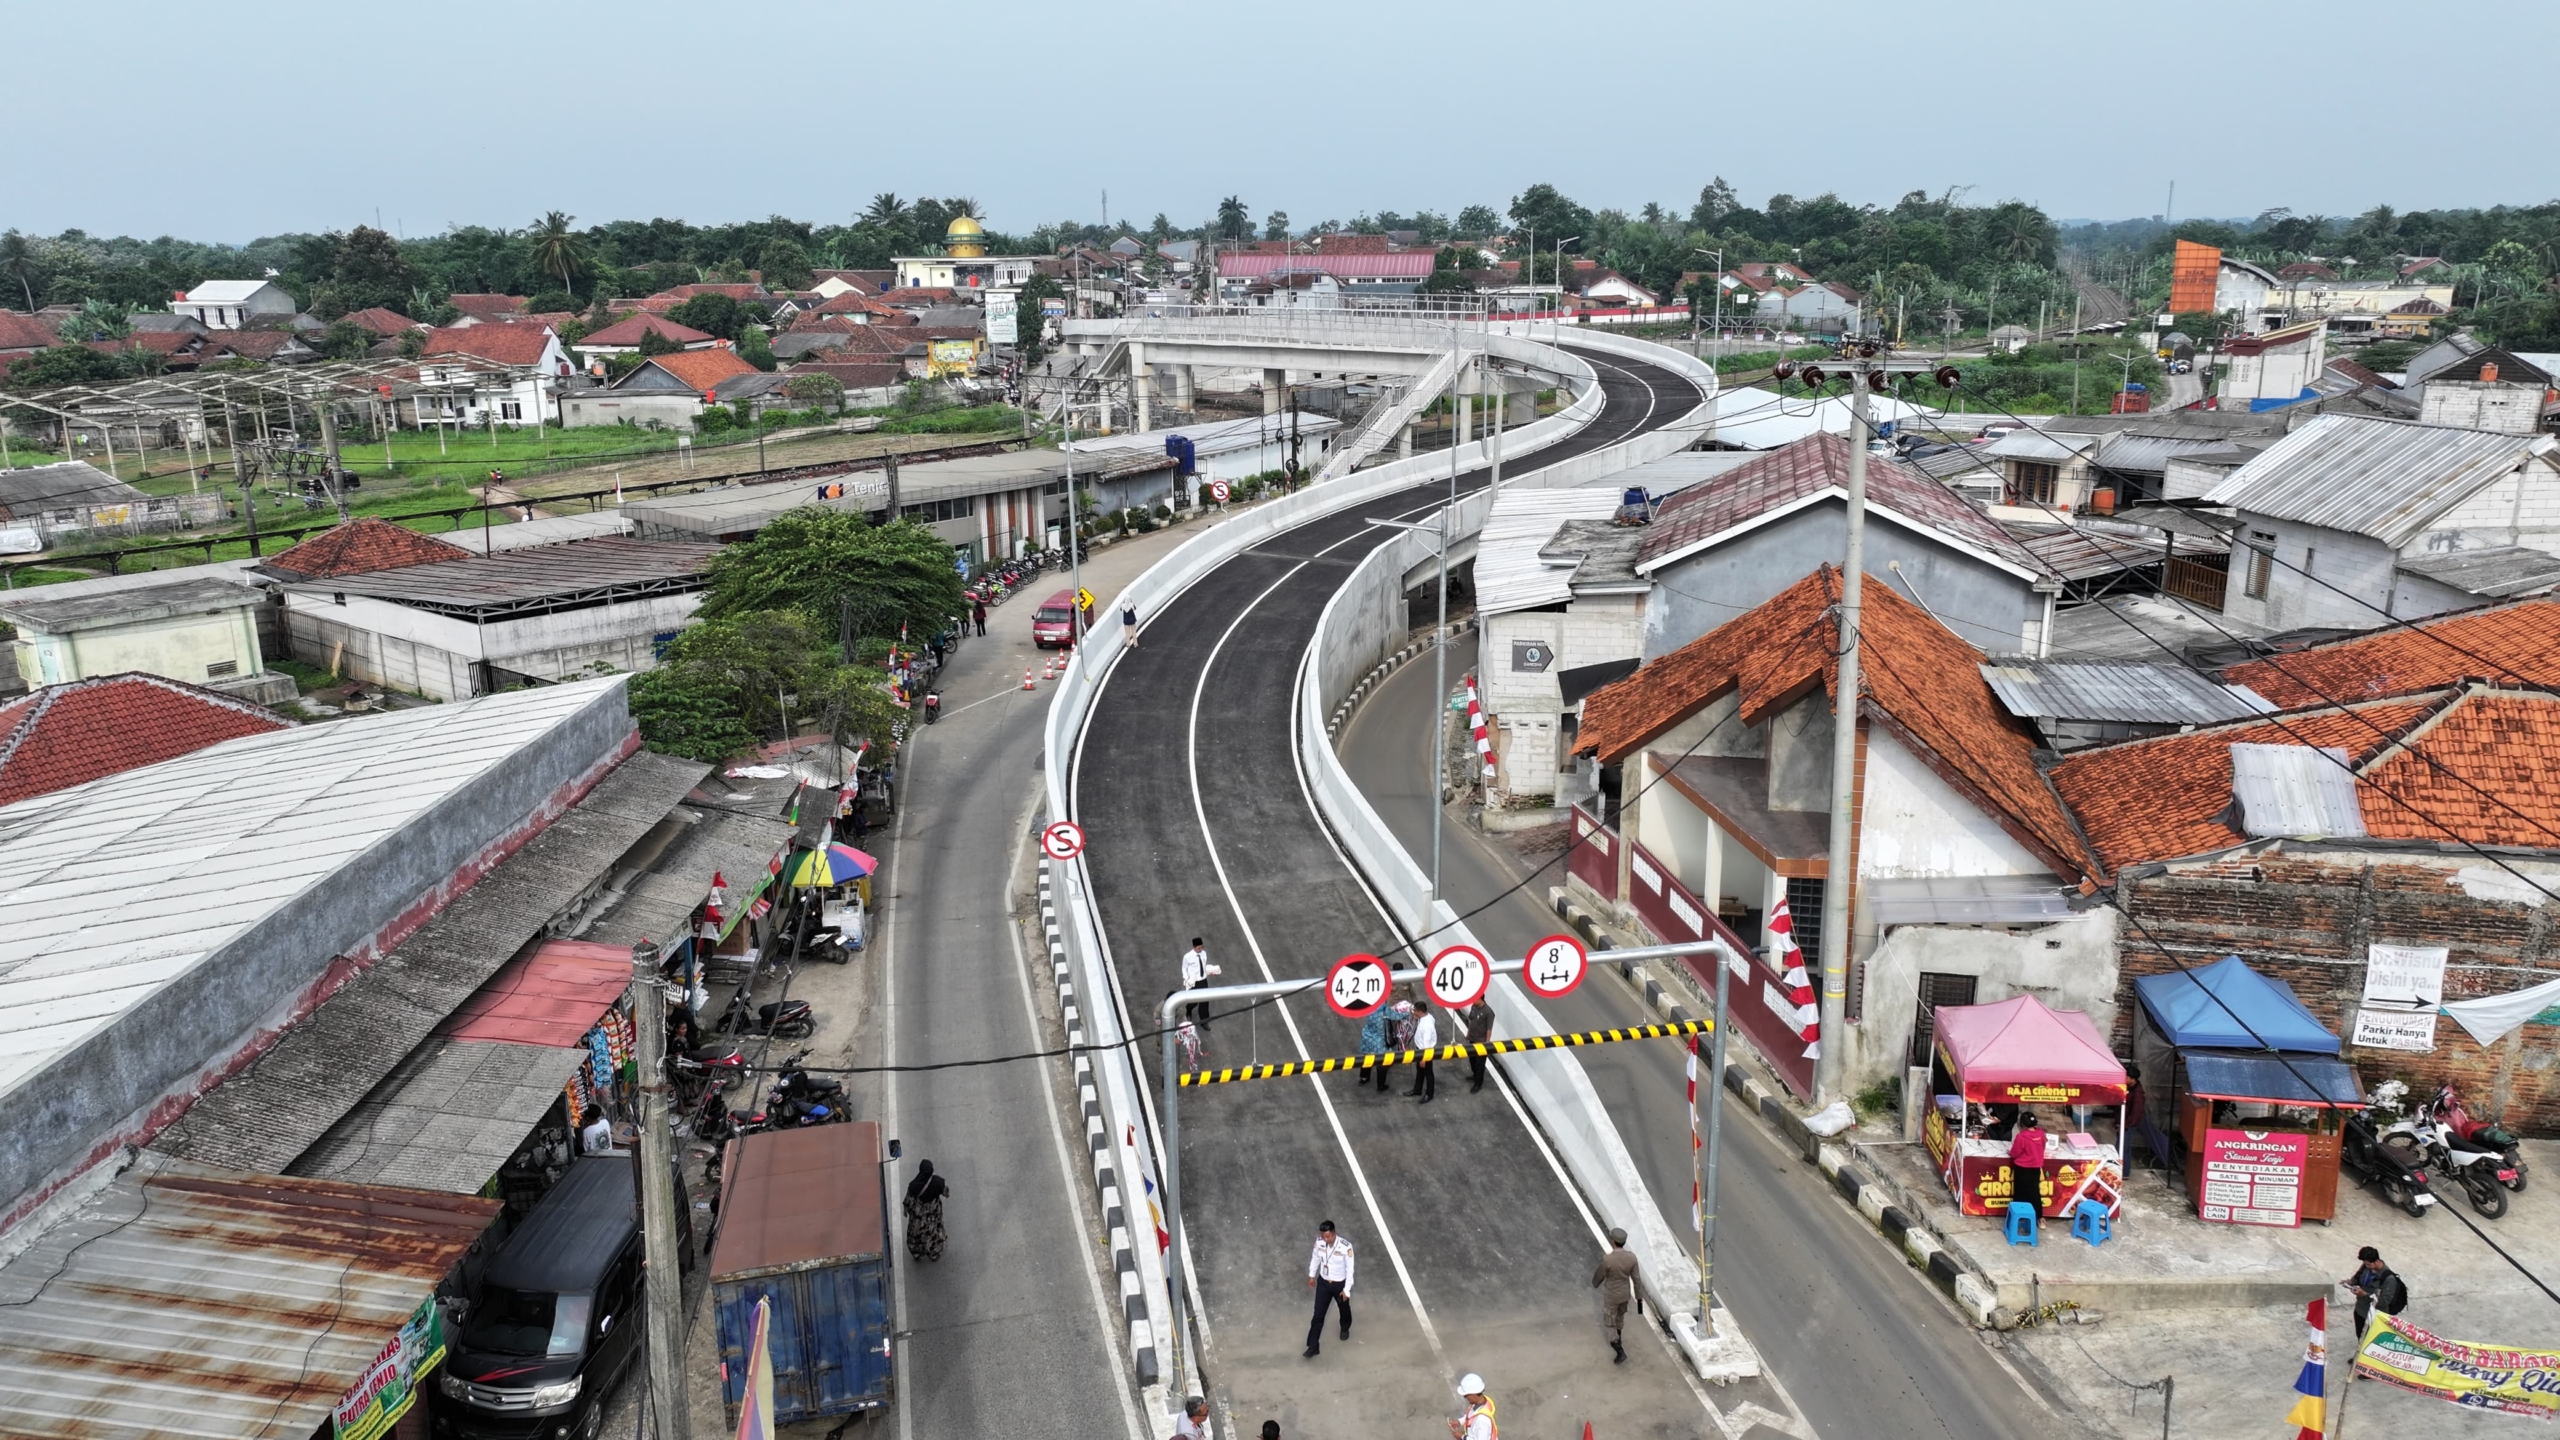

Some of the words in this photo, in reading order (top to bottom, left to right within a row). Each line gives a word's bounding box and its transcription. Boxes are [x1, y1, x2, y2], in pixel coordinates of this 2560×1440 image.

[818, 484, 844, 500] KAI
[1056, 829, 1074, 852] S
[1436, 966, 1465, 992] 40
[1465, 960, 1477, 970] km
[2368, 970, 2407, 987] Disini
[1335, 976, 1360, 999] 4,2
[1366, 977, 1380, 993] m
[2362, 1025, 2394, 1035] Parkir
[2395, 1028, 2427, 1039] Hanya
[2358, 1034, 2388, 1045] Untuk
[2391, 1037, 2428, 1048] PASIEN
[2007, 1086, 2032, 1096] RAJA
[2067, 1088, 2080, 1097] ISI
[2214, 1140, 2297, 1153] ANGKRINGAN
[2224, 1150, 2258, 1162] Stasiun
[2260, 1153, 2285, 1165] Tenjo
[2213, 1163, 2295, 1173] MENYEDIAKAN
[339, 1390, 370, 1428] PUTRA
[369, 1364, 397, 1398] TENJO
